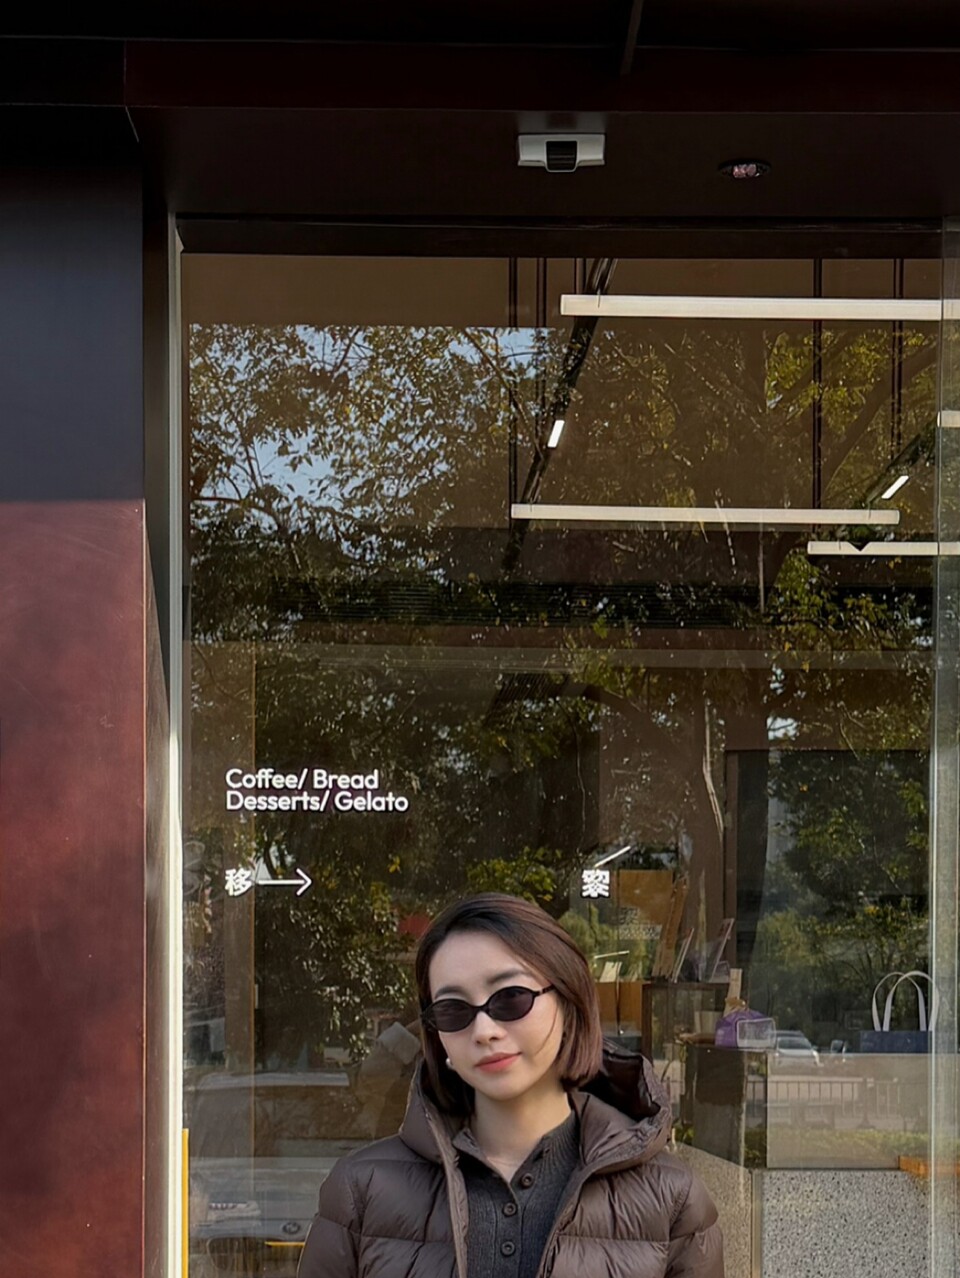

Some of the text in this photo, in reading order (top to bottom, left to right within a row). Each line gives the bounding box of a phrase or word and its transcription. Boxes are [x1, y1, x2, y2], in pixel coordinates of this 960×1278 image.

[225, 769, 379, 790] Coffee/ Bread
[226, 789, 409, 812] Desserts/ Gelato
[224, 867, 253, 897] 移
